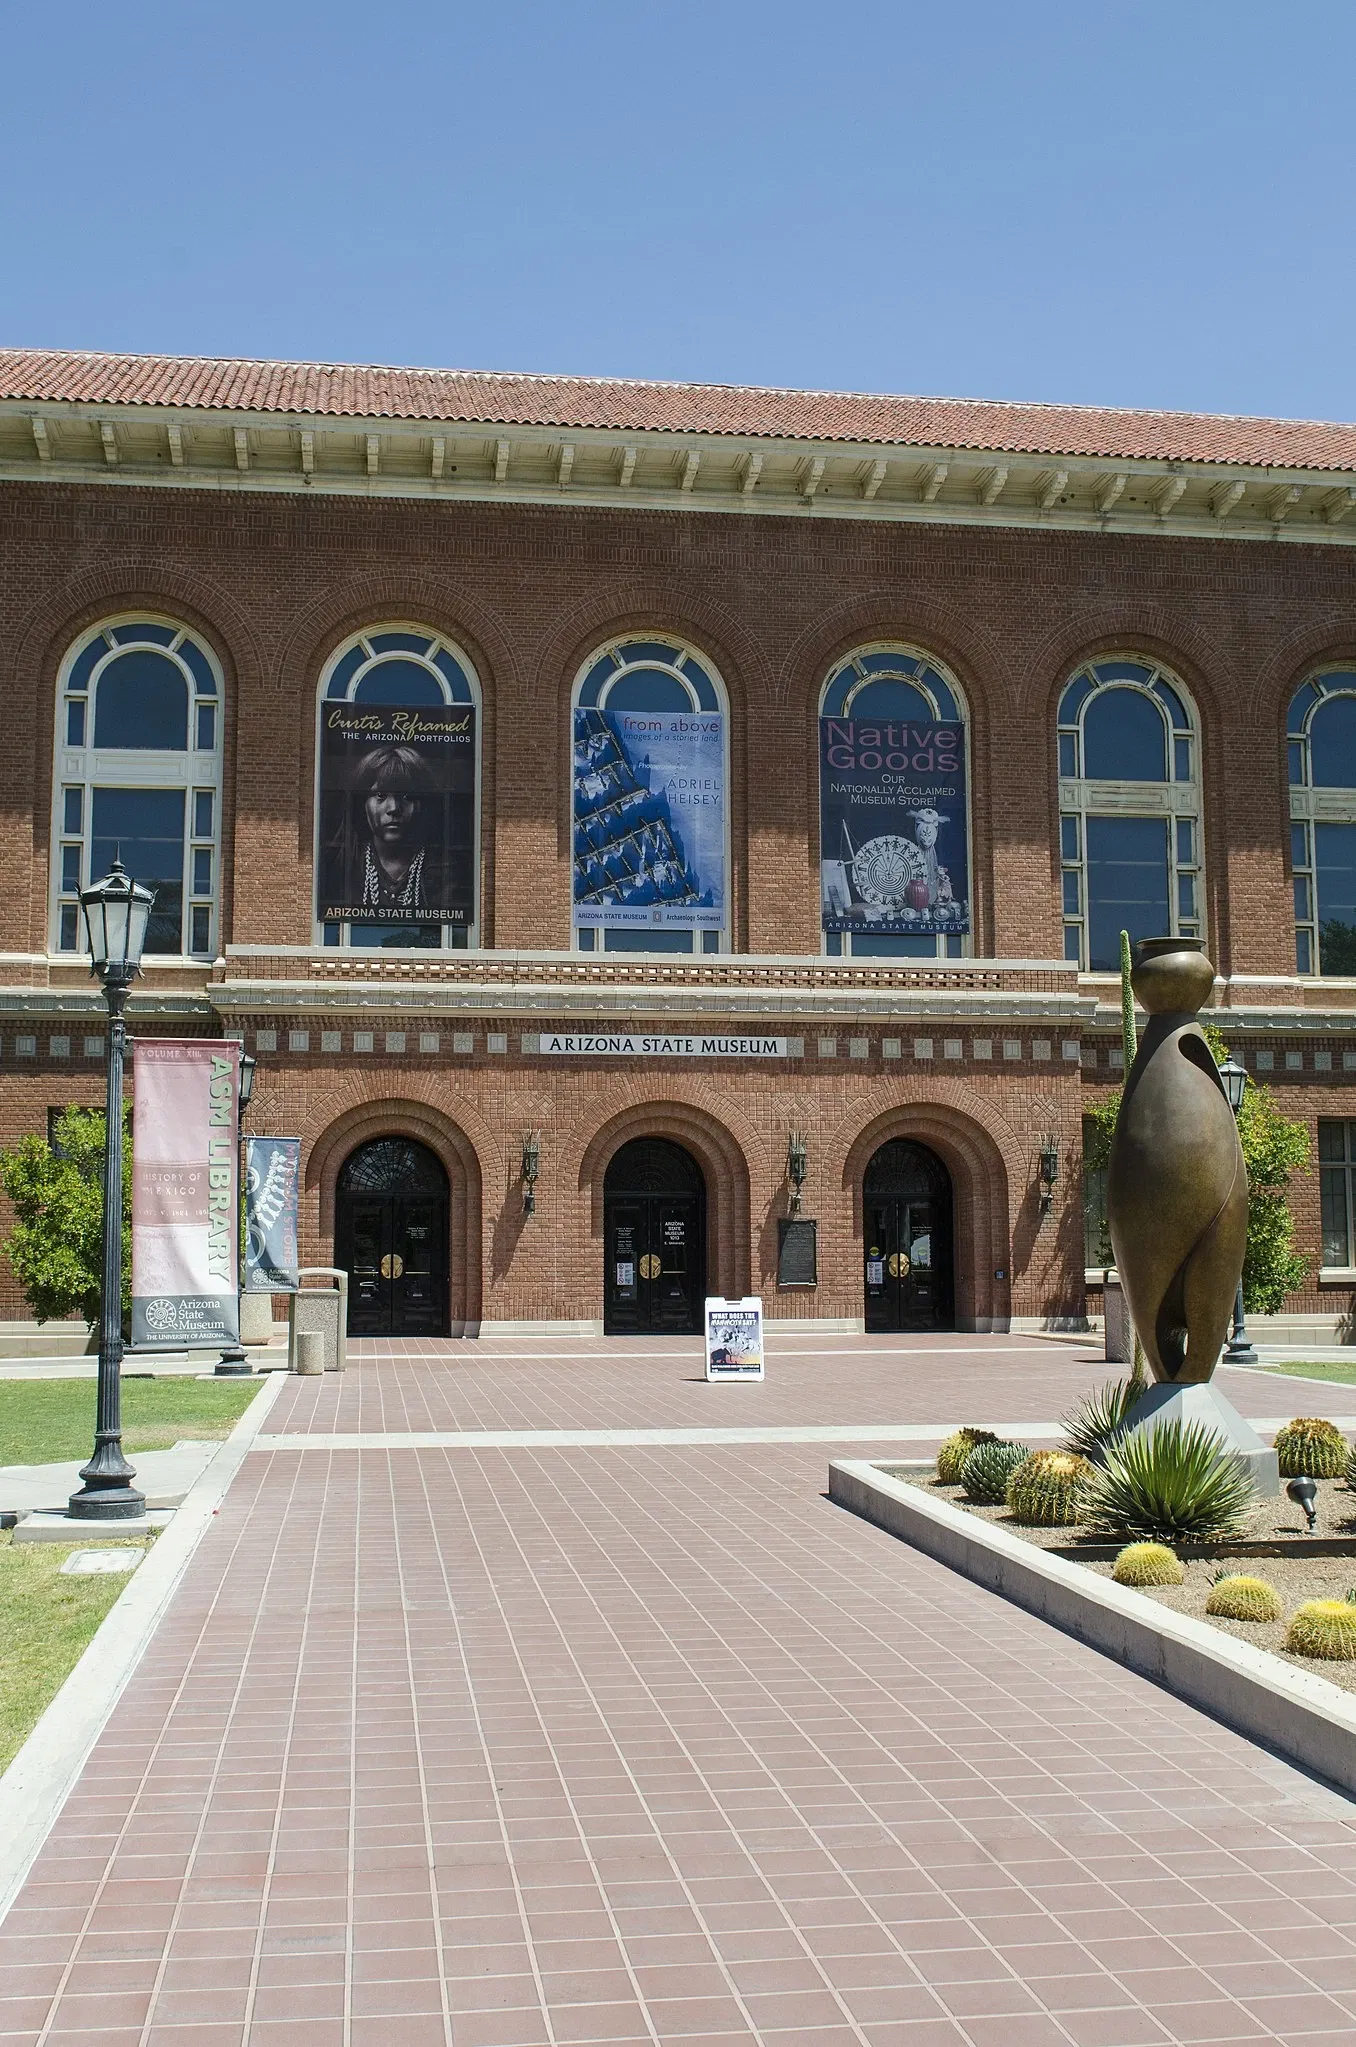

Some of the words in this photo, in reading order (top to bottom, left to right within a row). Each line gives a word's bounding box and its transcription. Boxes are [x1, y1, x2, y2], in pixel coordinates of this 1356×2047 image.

[328, 709, 385, 729] Curtis
[392, 712, 470, 740] Reframed
[623, 716, 662, 731] from
[670, 719, 719, 732] above
[342, 732, 360, 740] THE
[365, 733, 406, 741] ARIZONA
[414, 735, 470, 743] PORTFOLIOS
[623, 733, 651, 742] images
[654, 734, 662, 742] of
[827, 721, 957, 749] Native
[827, 744, 959, 772] Goods
[667, 778, 720, 790] ADRIEL
[668, 793, 719, 805] HEISEY
[326, 907, 376, 917] ARIZONA
[378, 908, 412, 918] STATE
[415, 909, 464, 919] MUSEUM
[667, 914, 696, 922] Archaeology
[697, 914, 721, 922] Southwest
[550, 1037, 635, 1051] ARIZONA
[642, 1038, 694, 1052] STATE
[701, 1040, 779, 1054] MUSEUM
[141, 1050, 180, 1058] VOLUME
[209, 1055, 233, 1127] ASM
[189, 1173, 202, 1182] OF
[283, 1143, 295, 1211] MUSEUM
[142, 1186, 196, 1196] MEXICO
[208, 1138, 232, 1282] LIBRARY
[283, 1216, 294, 1266] STORE
[178, 1299, 221, 1309] Arizona
[178, 1309, 204, 1319] State
[711, 1312, 728, 1320] WHAT
[728, 1312, 744, 1320] DOES
[744, 1312, 756, 1320] THE
[178, 1319, 225, 1330] Museum
